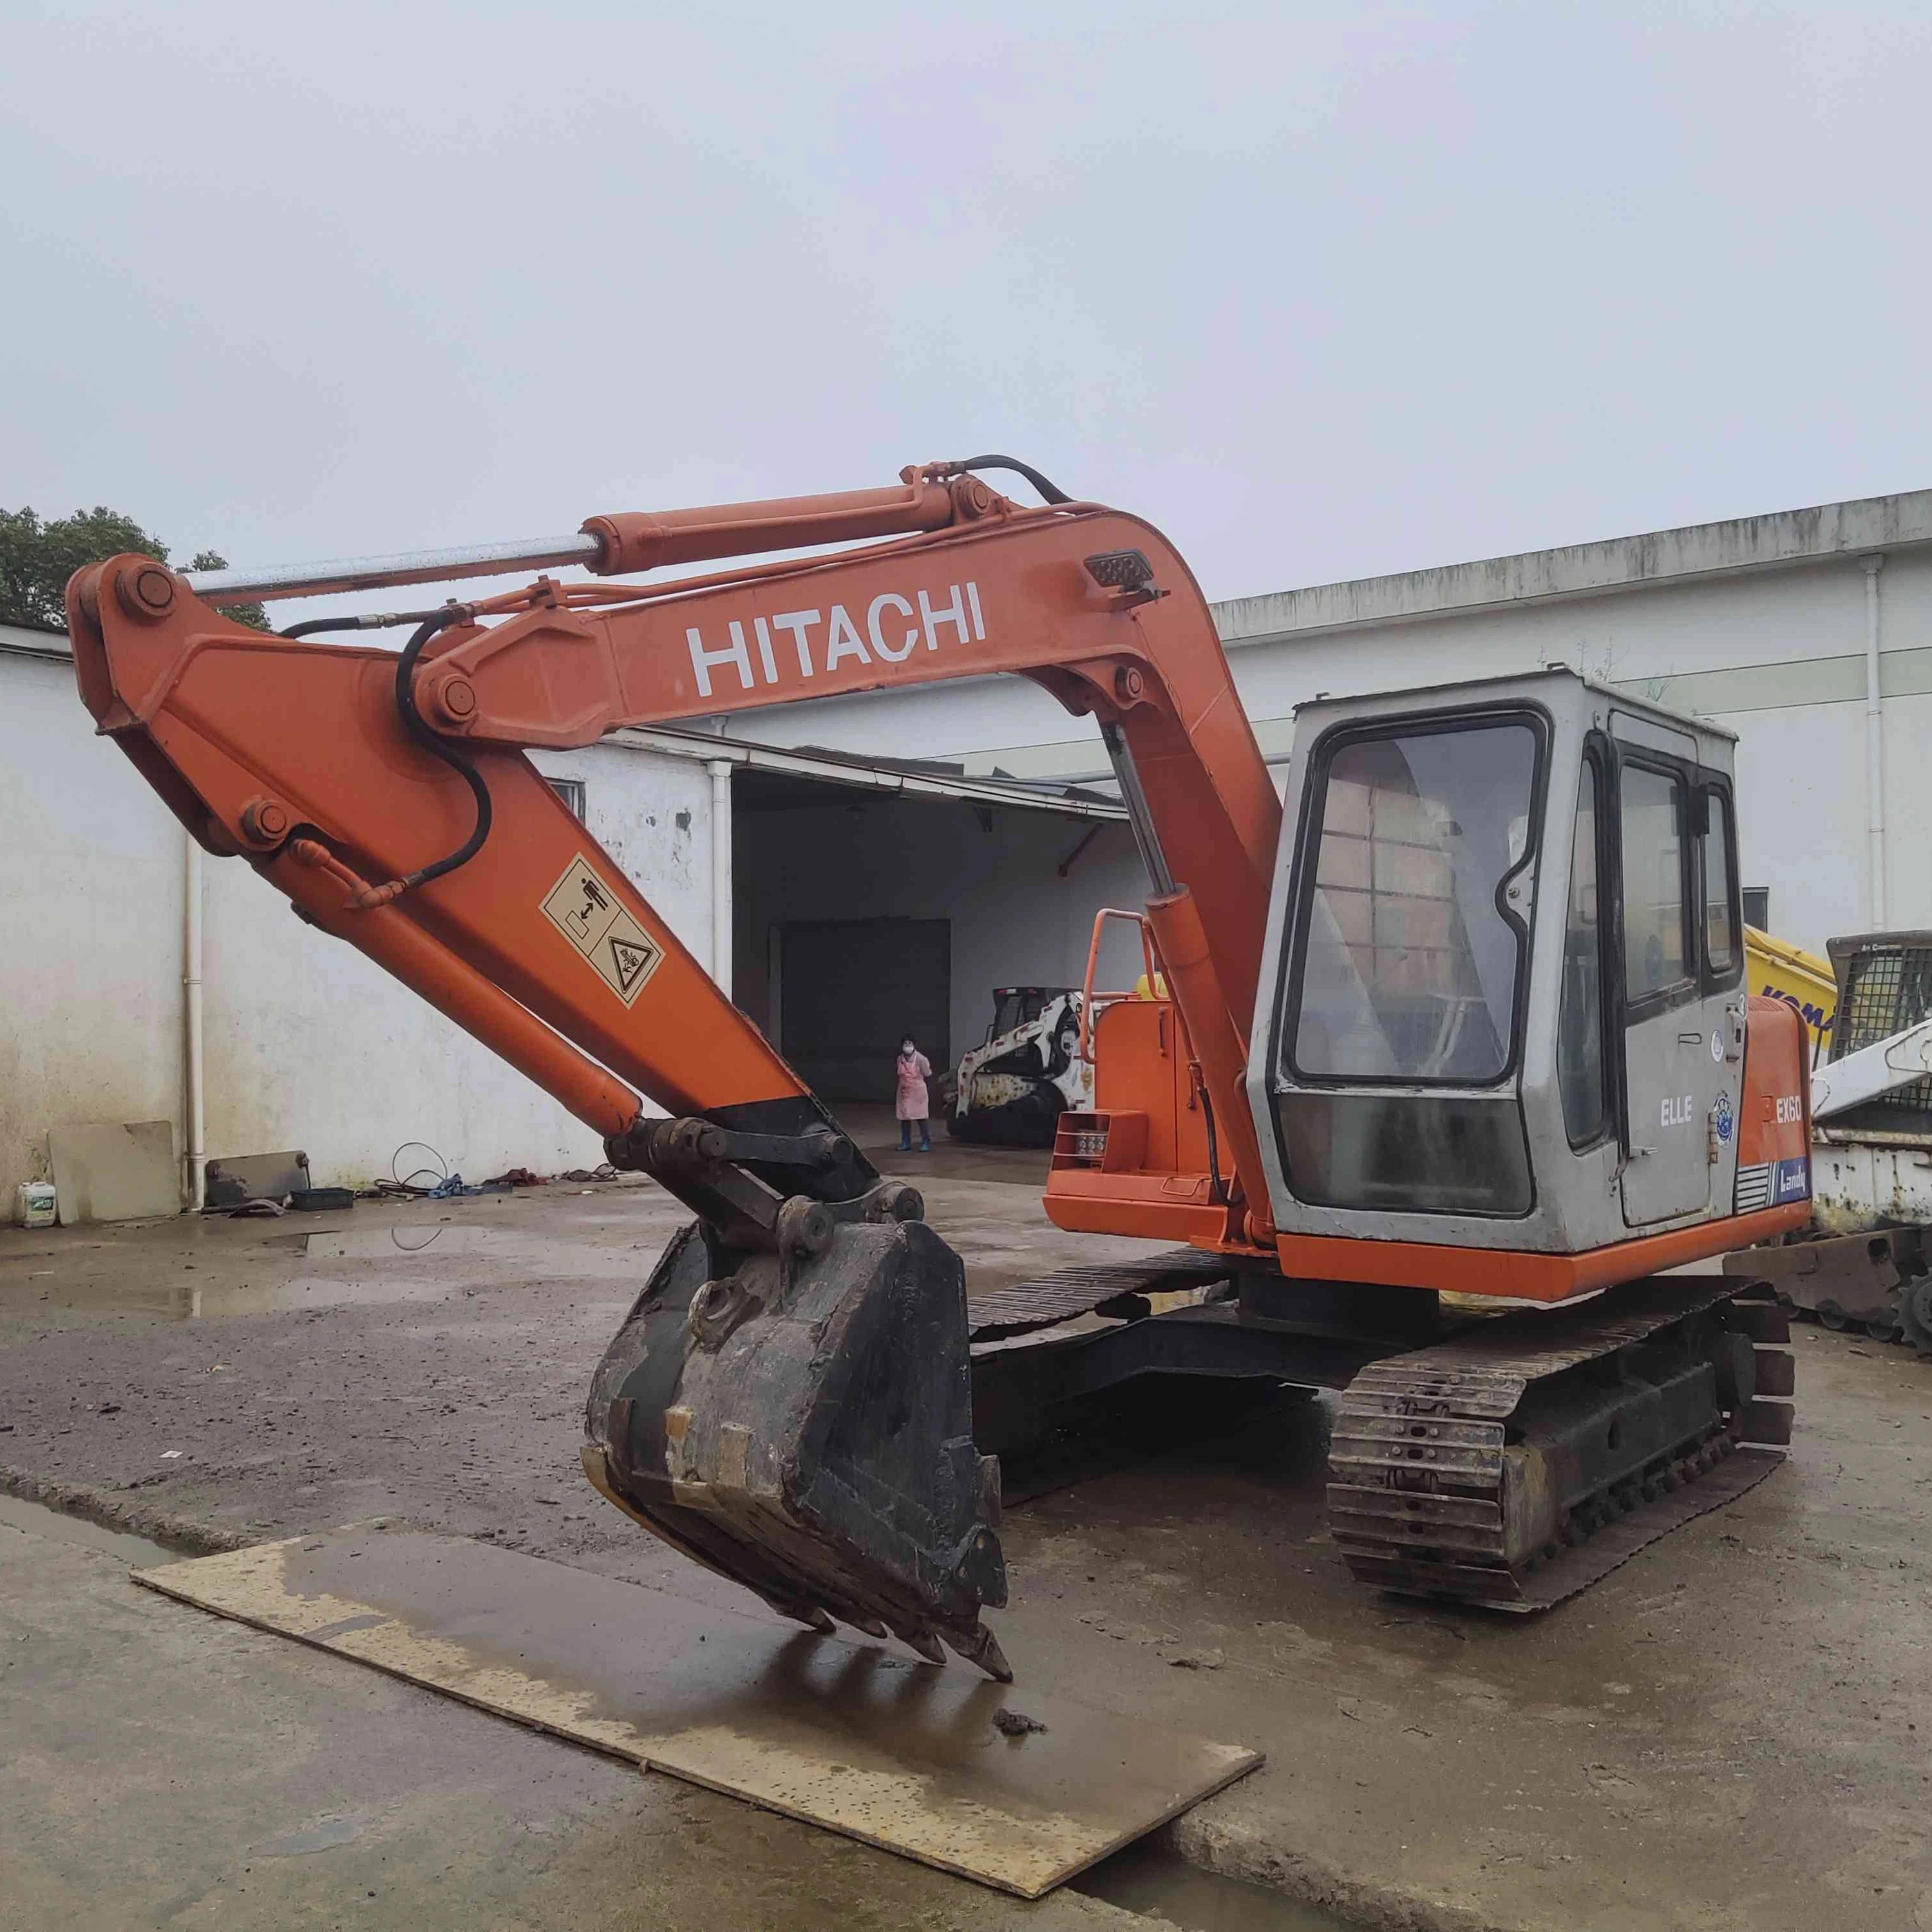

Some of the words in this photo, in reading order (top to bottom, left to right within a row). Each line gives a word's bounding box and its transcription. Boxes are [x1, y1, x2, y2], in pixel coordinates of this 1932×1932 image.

[685, 581, 986, 697] HITACHI
[1661, 1095, 1692, 1126] ELLE
[1776, 1095, 1802, 1124] EX60
[1780, 1165, 1806, 1193] Landy
